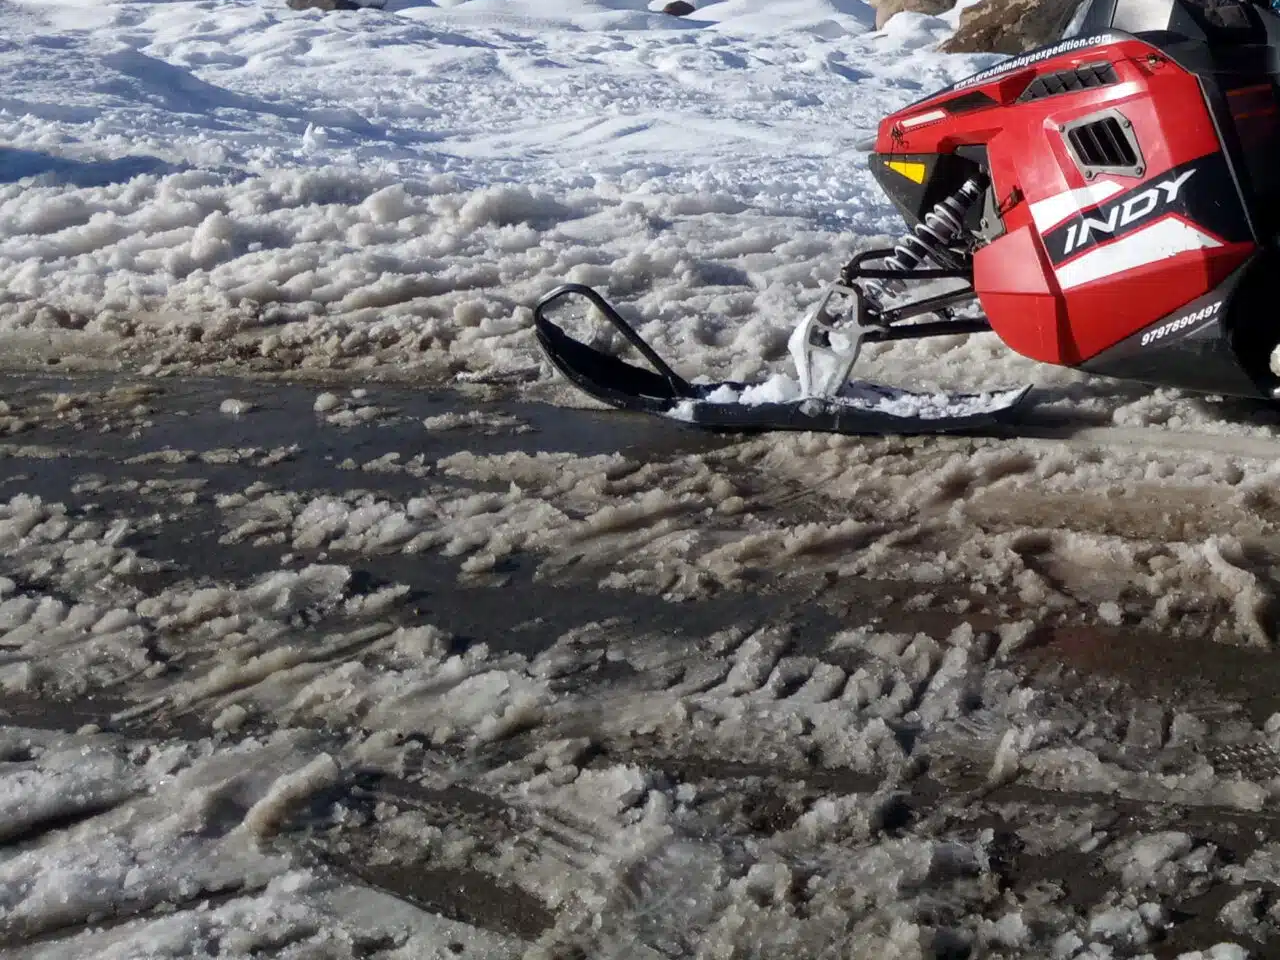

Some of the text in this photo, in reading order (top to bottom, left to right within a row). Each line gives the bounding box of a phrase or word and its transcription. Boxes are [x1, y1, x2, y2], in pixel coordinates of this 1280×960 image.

[953, 33, 1112, 91] www.greathimalayaexpedition.com
[1063, 168, 1197, 255] INDY
[1140, 300, 1222, 346] 9797890497
